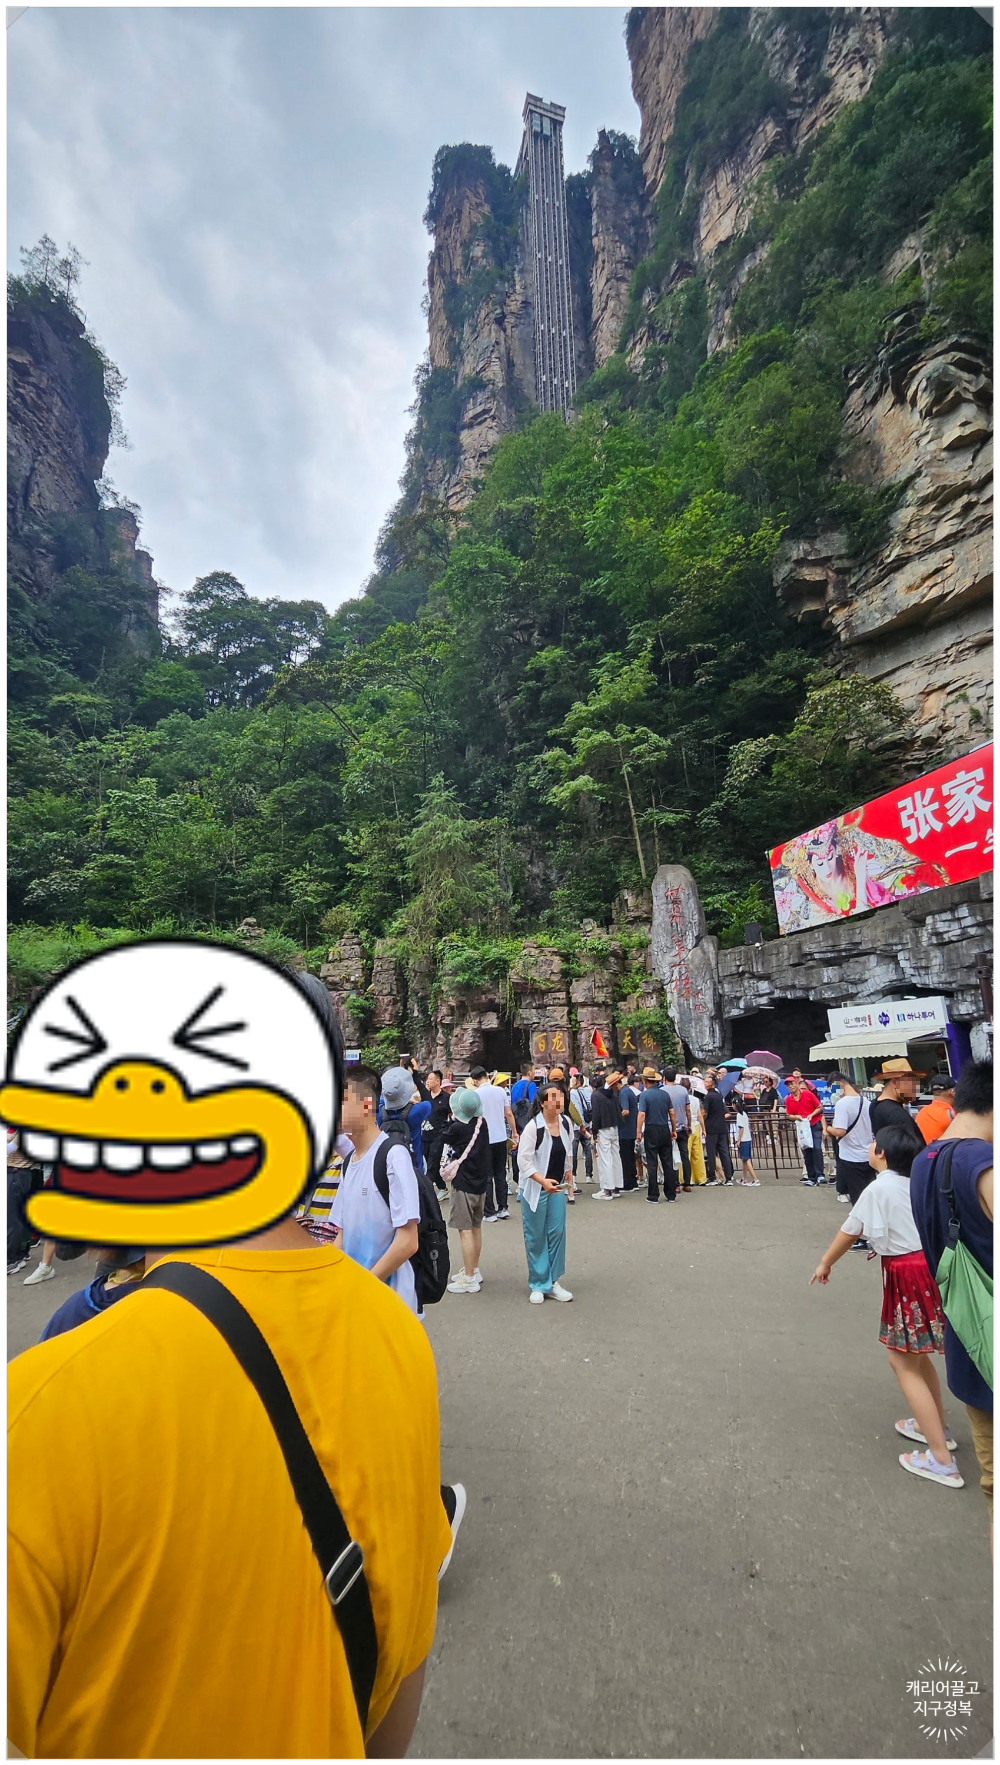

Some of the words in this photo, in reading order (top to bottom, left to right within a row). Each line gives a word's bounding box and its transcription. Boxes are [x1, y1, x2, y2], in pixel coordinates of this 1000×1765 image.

[897, 767, 992, 844] 张家
[906, 1011, 936, 1021] 하나투어
[533, 1031, 566, 1053] 百龙
